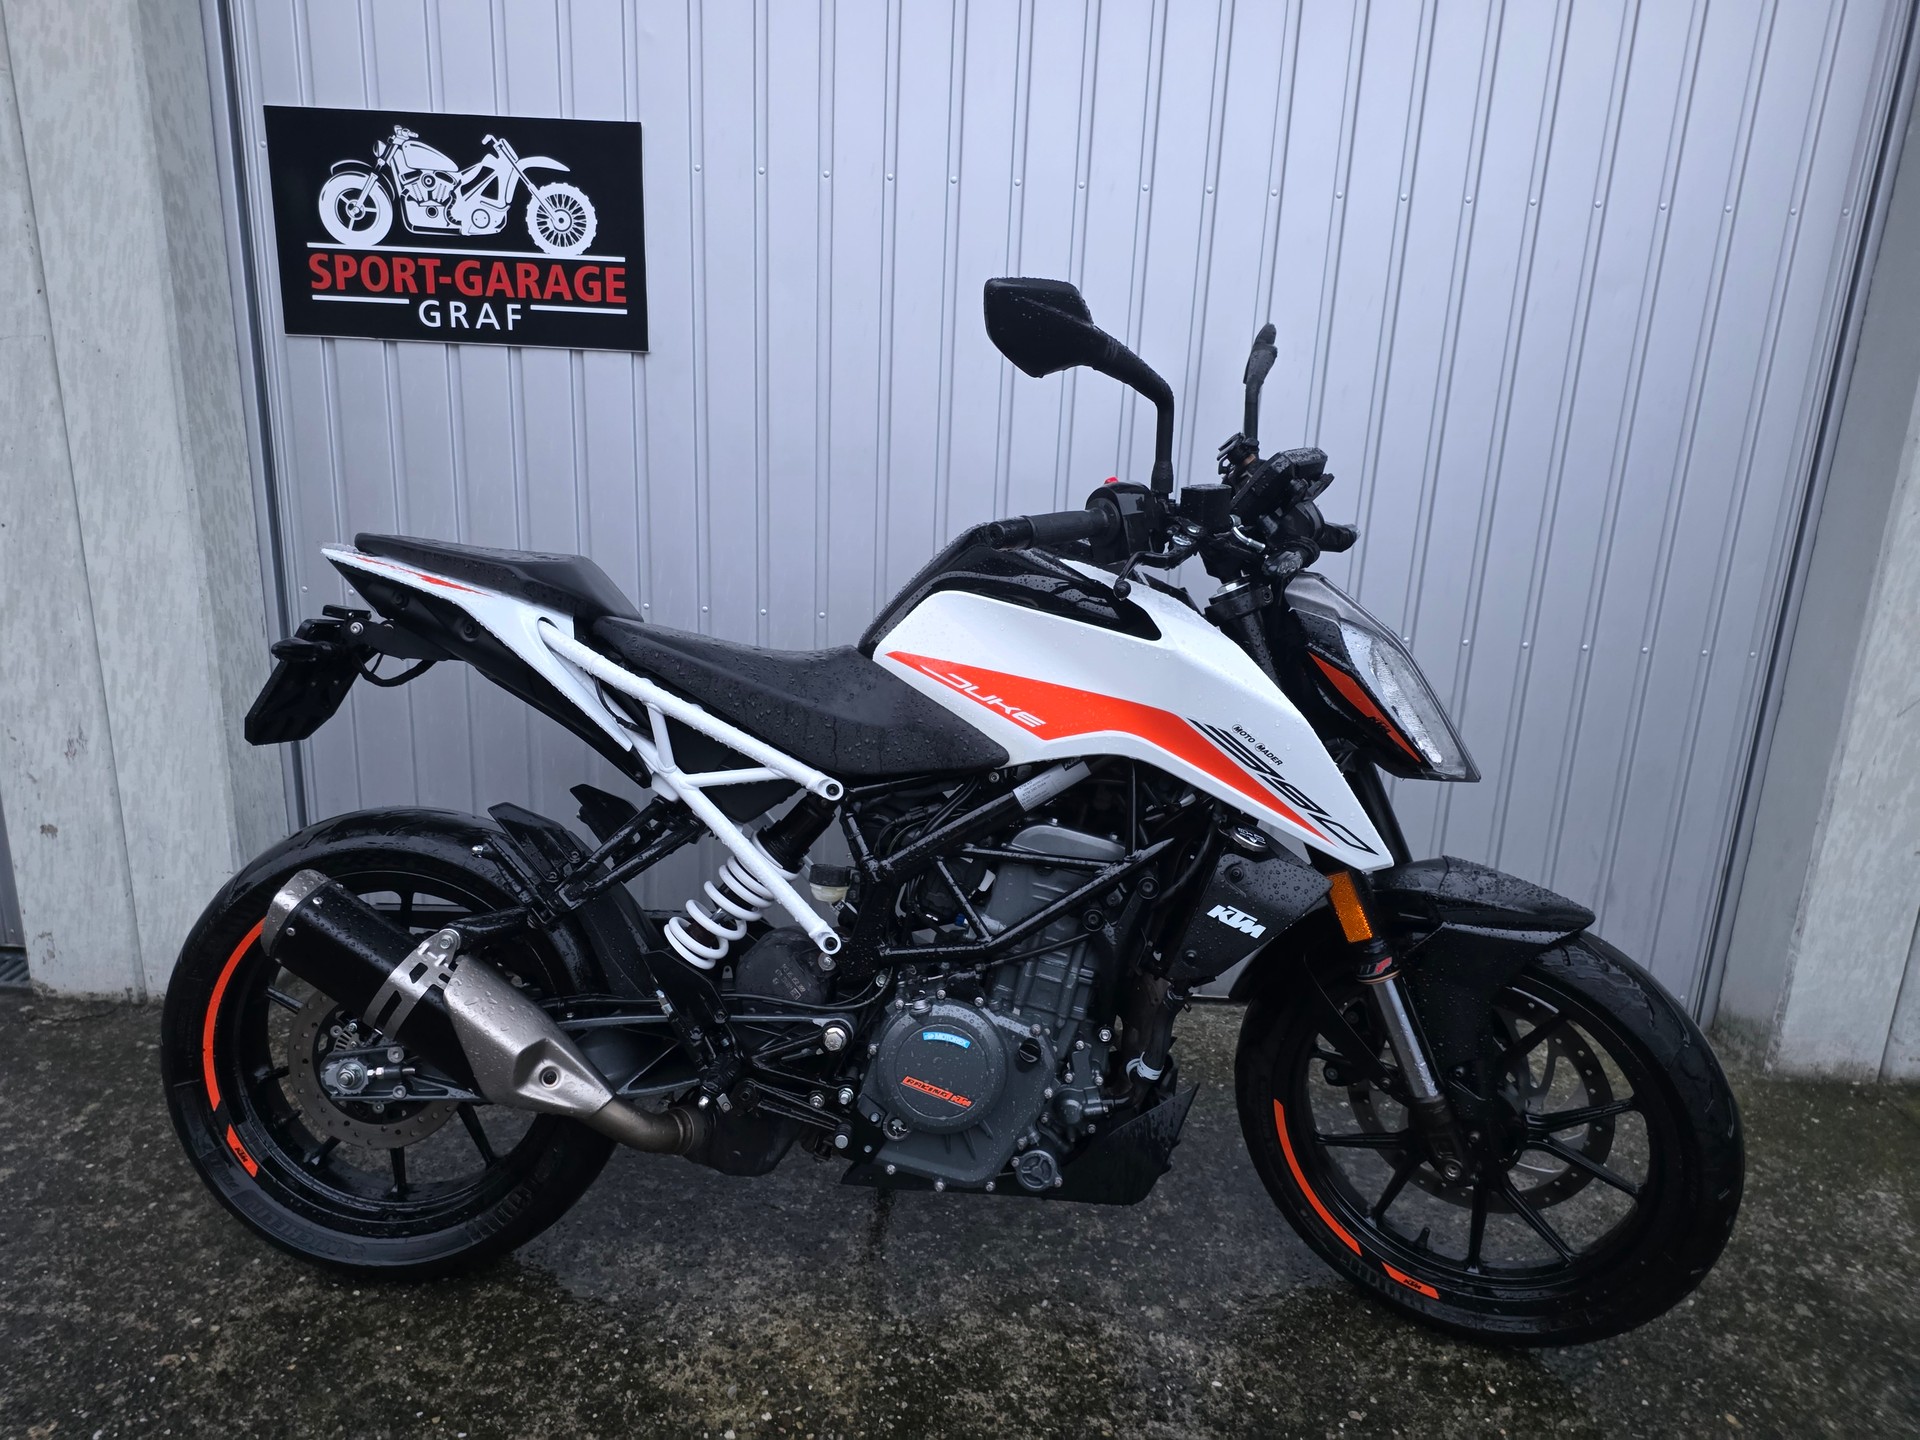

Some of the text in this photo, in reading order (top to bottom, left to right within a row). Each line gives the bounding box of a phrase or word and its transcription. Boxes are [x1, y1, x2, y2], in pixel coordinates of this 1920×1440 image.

[307, 252, 627, 304] SPORT-GARAGE
[418, 299, 523, 331] GRAF
[919, 664, 1047, 728] DUKE
[1232, 724, 1284, 766] MOTO MADER
[1206, 904, 1267, 939] KTM
[906, 1077, 948, 1099] RACING
[234, 1147, 249, 1163] KTM
[1403, 1278, 1422, 1290] KTM
